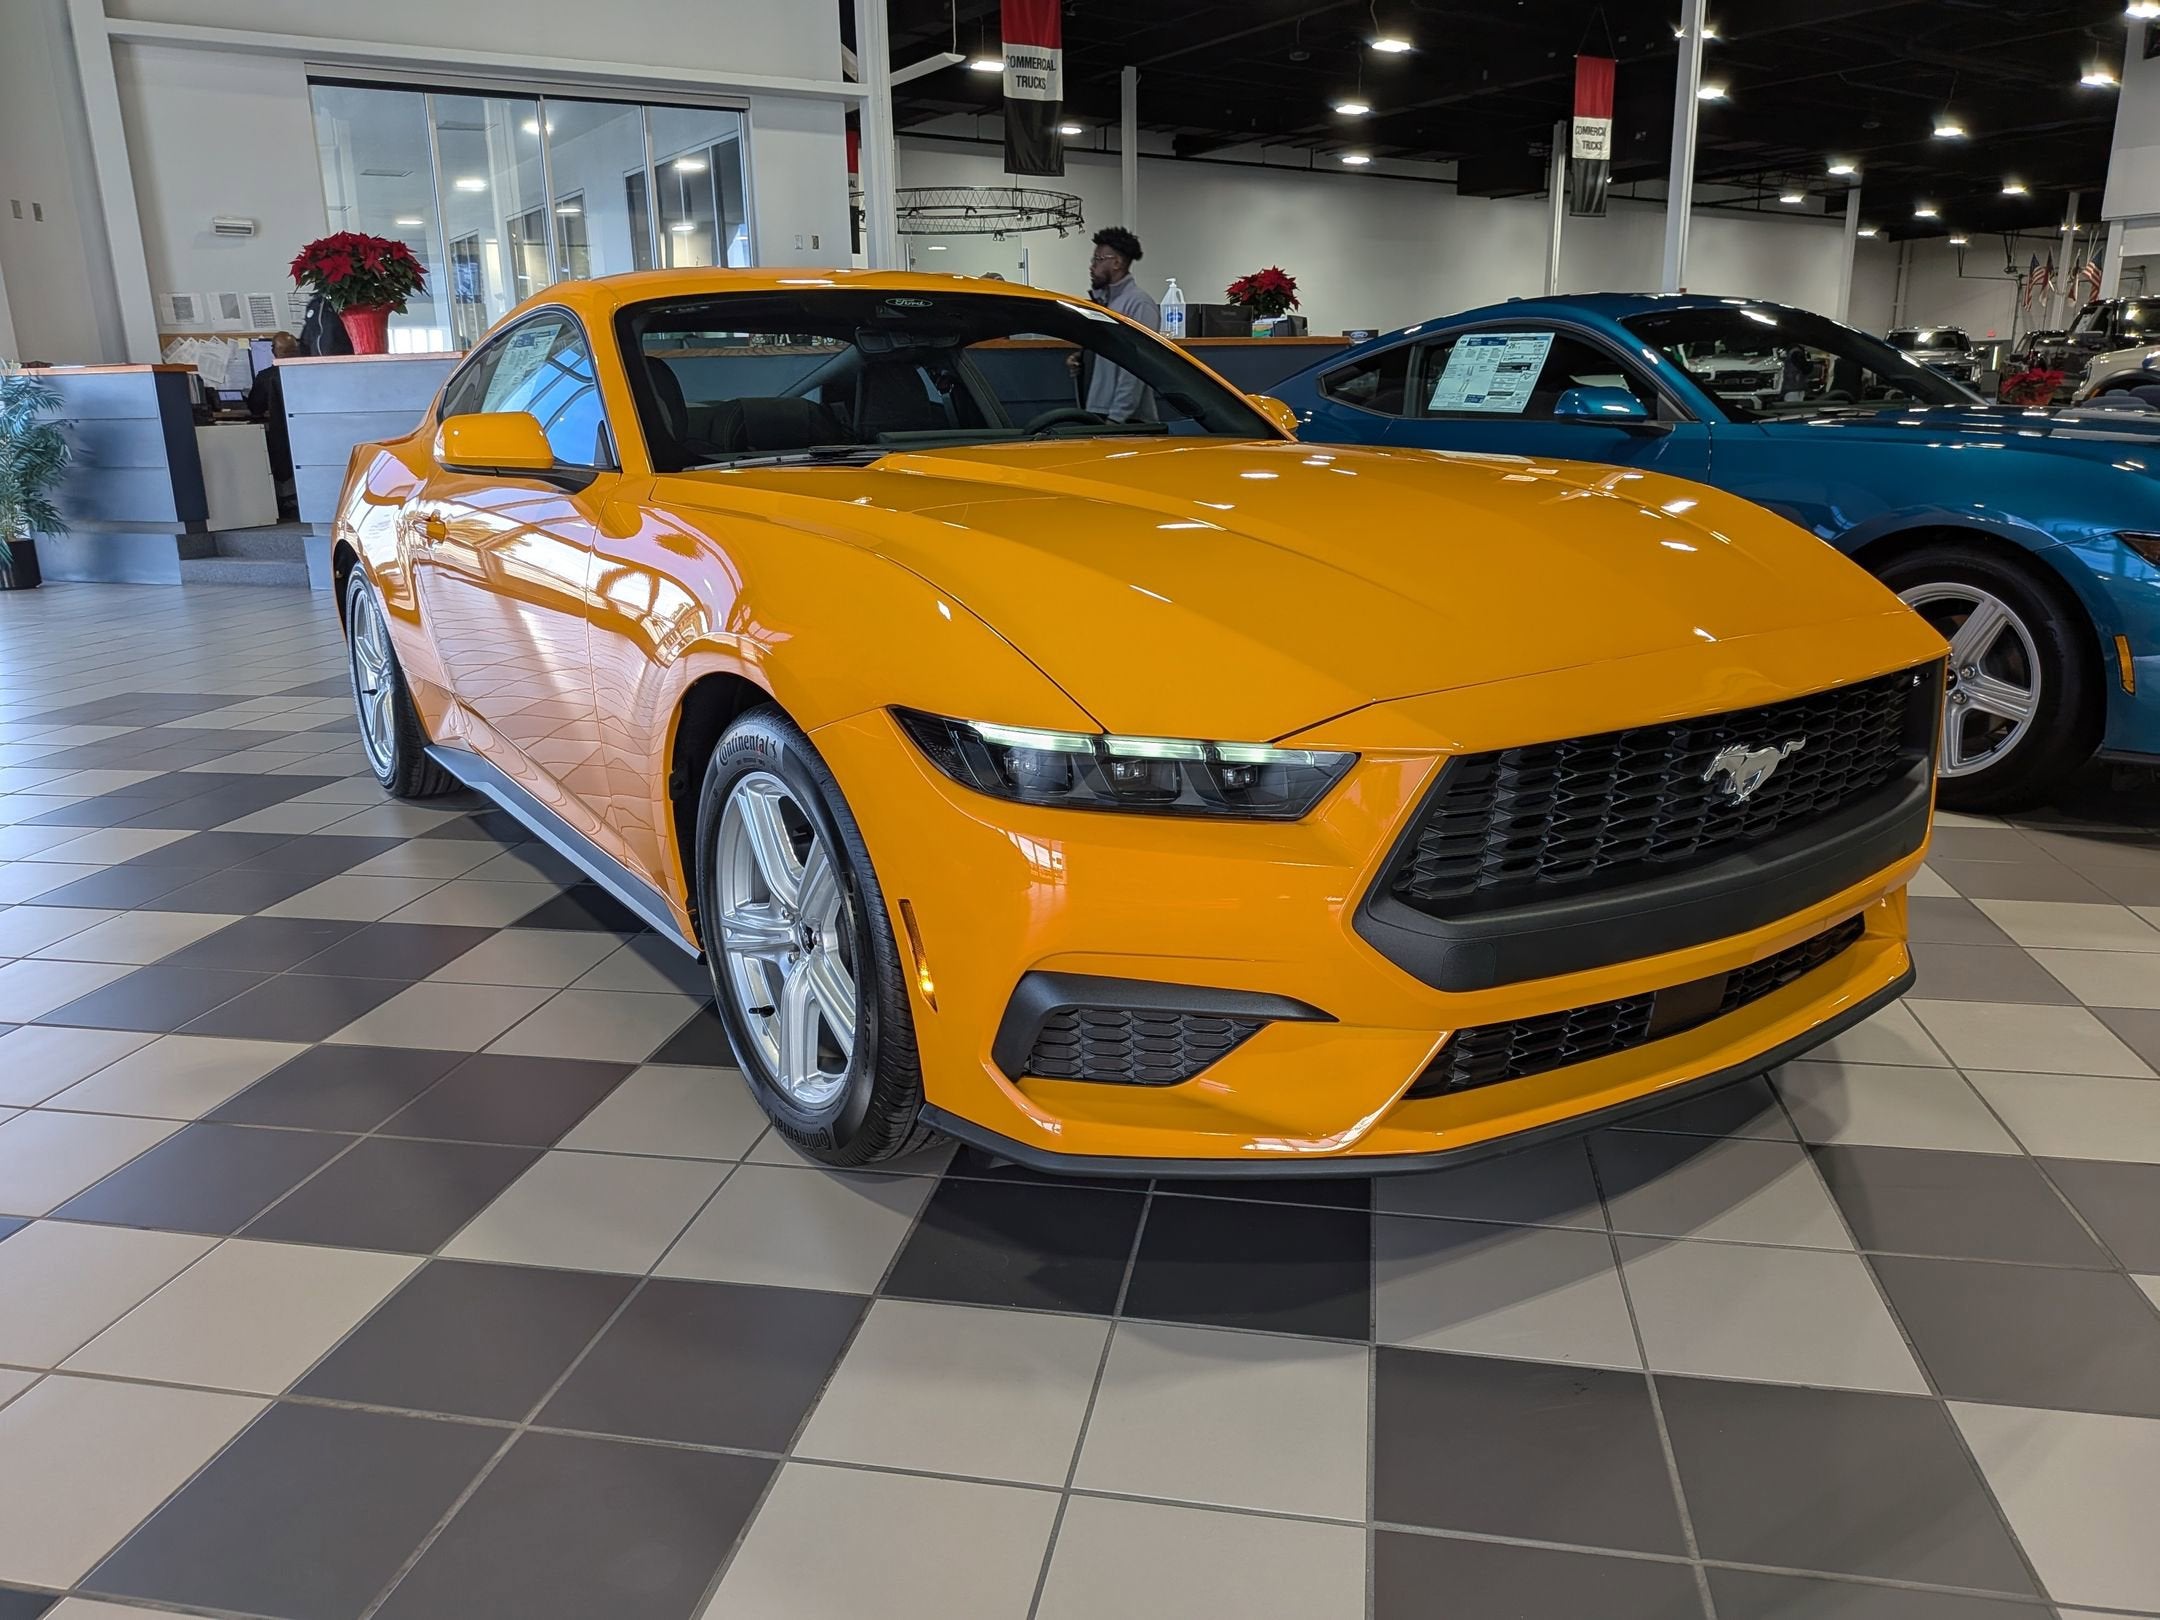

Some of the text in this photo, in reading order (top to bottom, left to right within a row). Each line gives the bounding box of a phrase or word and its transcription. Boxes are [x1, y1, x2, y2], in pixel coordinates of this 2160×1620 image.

[1016, 75, 1046, 89] TRUCKS
[720, 732, 769, 767] Continental
[774, 1113, 832, 1151] Continental
